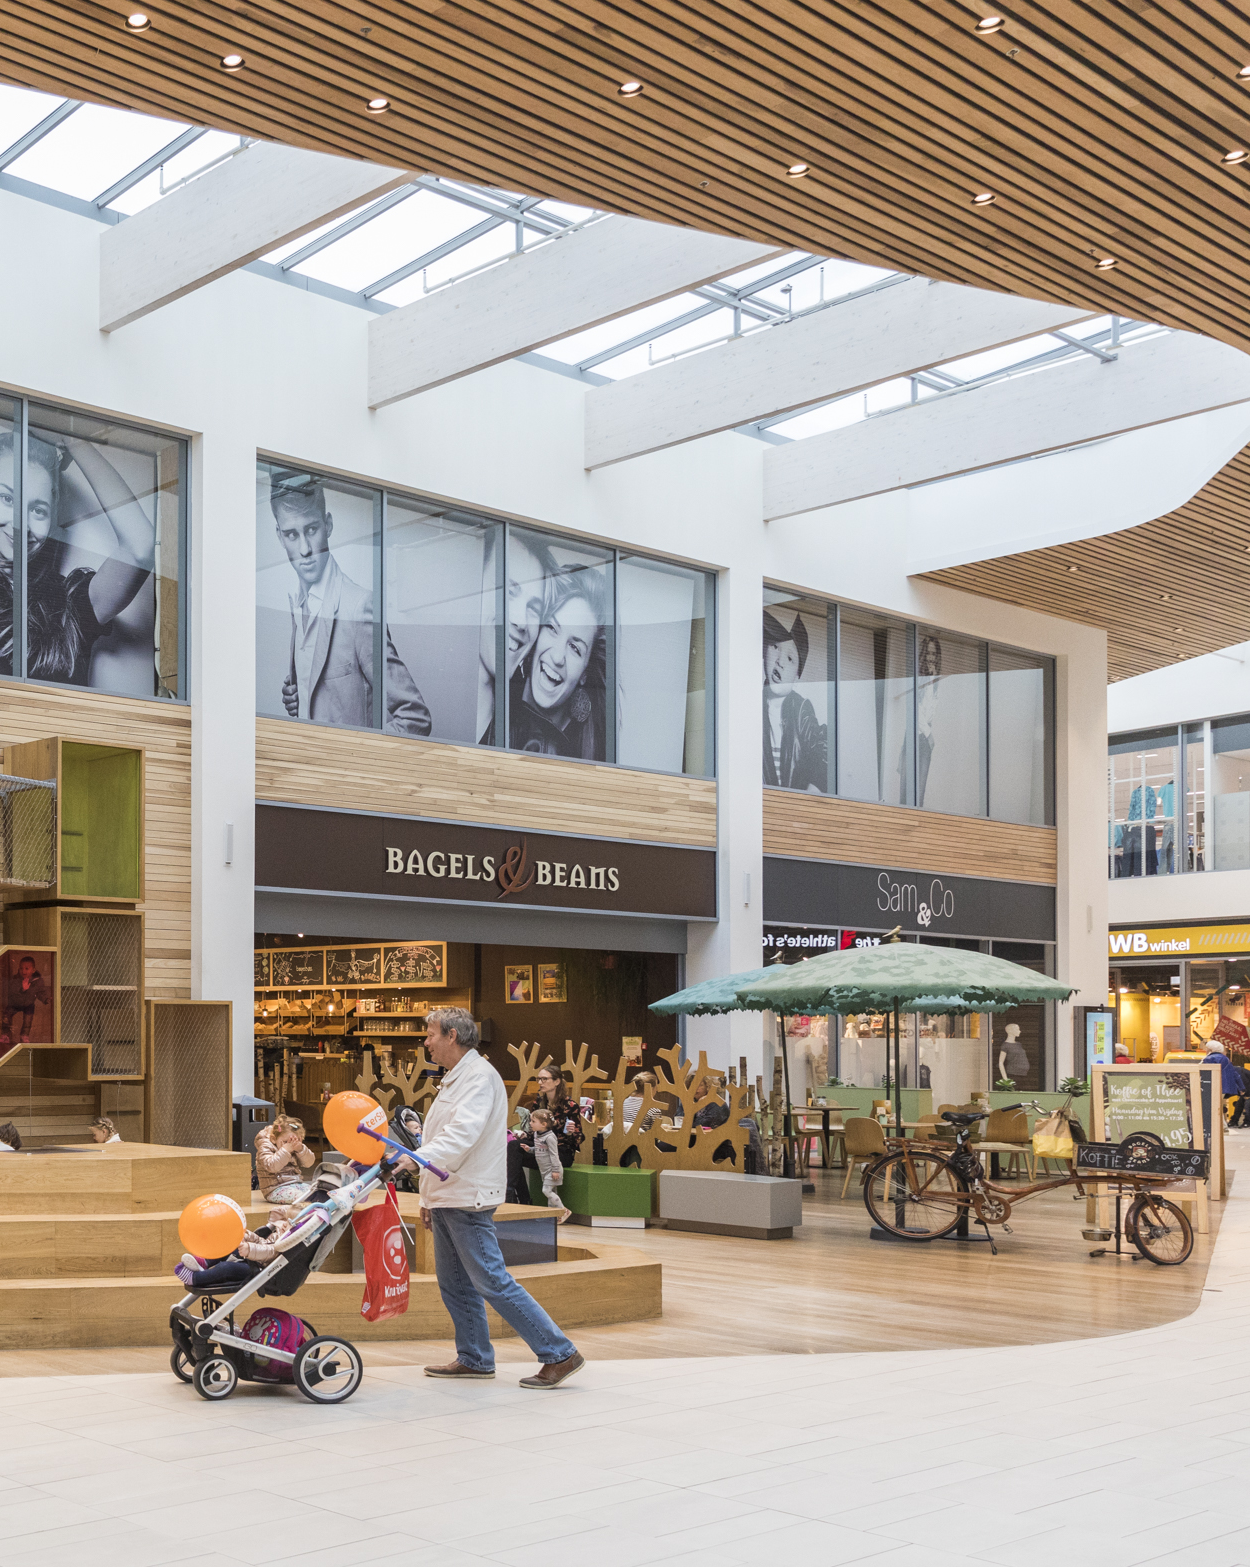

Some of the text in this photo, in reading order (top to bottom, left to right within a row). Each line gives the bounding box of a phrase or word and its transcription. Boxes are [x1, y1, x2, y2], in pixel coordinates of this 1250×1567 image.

[385, 836, 620, 899] BAGELS & BEANS
[877, 872, 955, 928] Sam & Co
[1150, 938, 1190, 952] winkel
[1110, 1084, 1183, 1099] Koffie of Thee
[1158, 1106, 1183, 1116] Vrijdag
